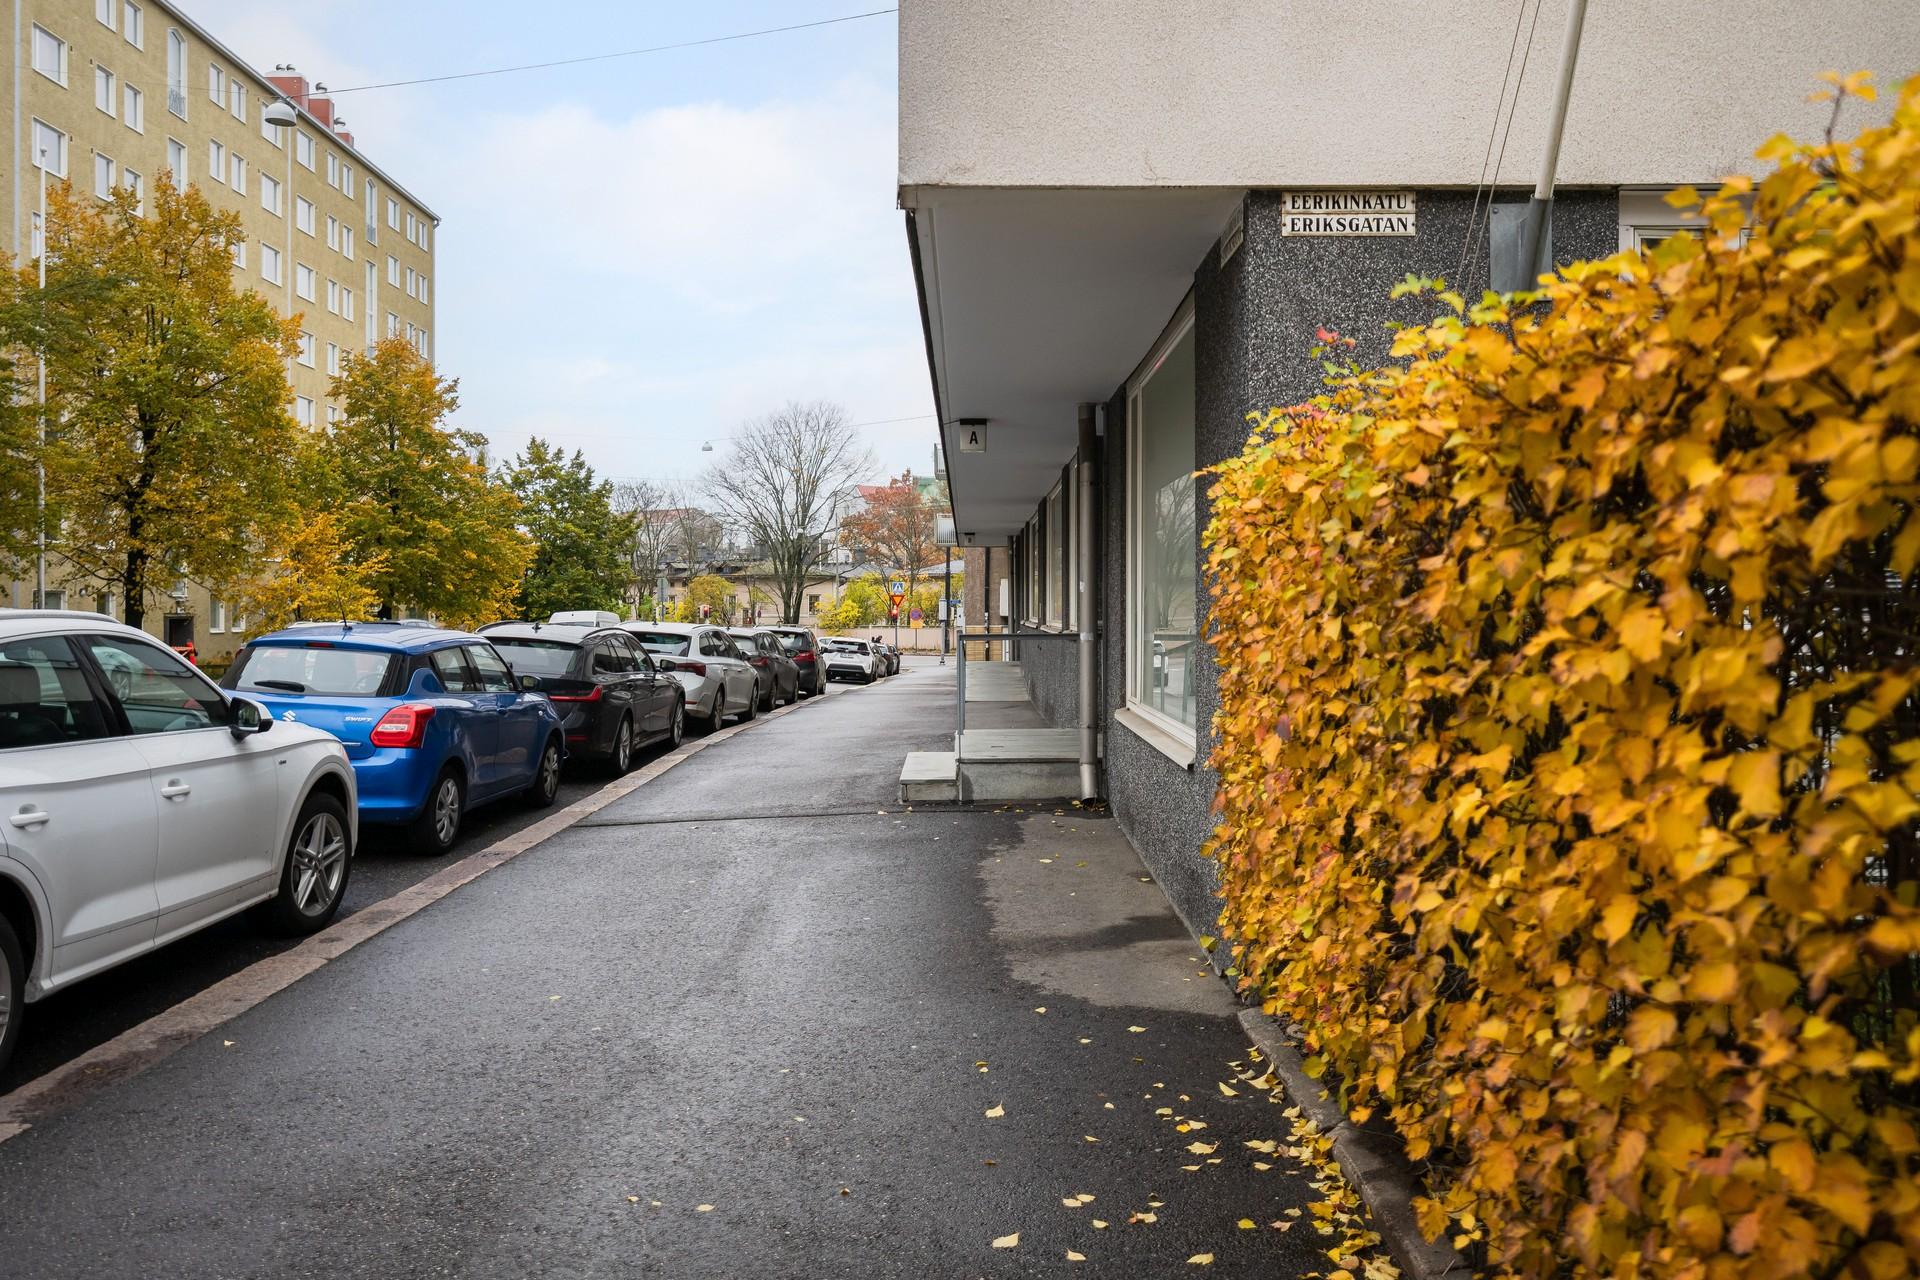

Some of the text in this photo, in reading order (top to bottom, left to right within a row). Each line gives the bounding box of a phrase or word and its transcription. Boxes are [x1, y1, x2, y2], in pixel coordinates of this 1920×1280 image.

[1291, 194, 1407, 210] EERIKINKATU
[1290, 217, 1408, 232] ERIKSGATAN
[969, 431, 979, 445] A
